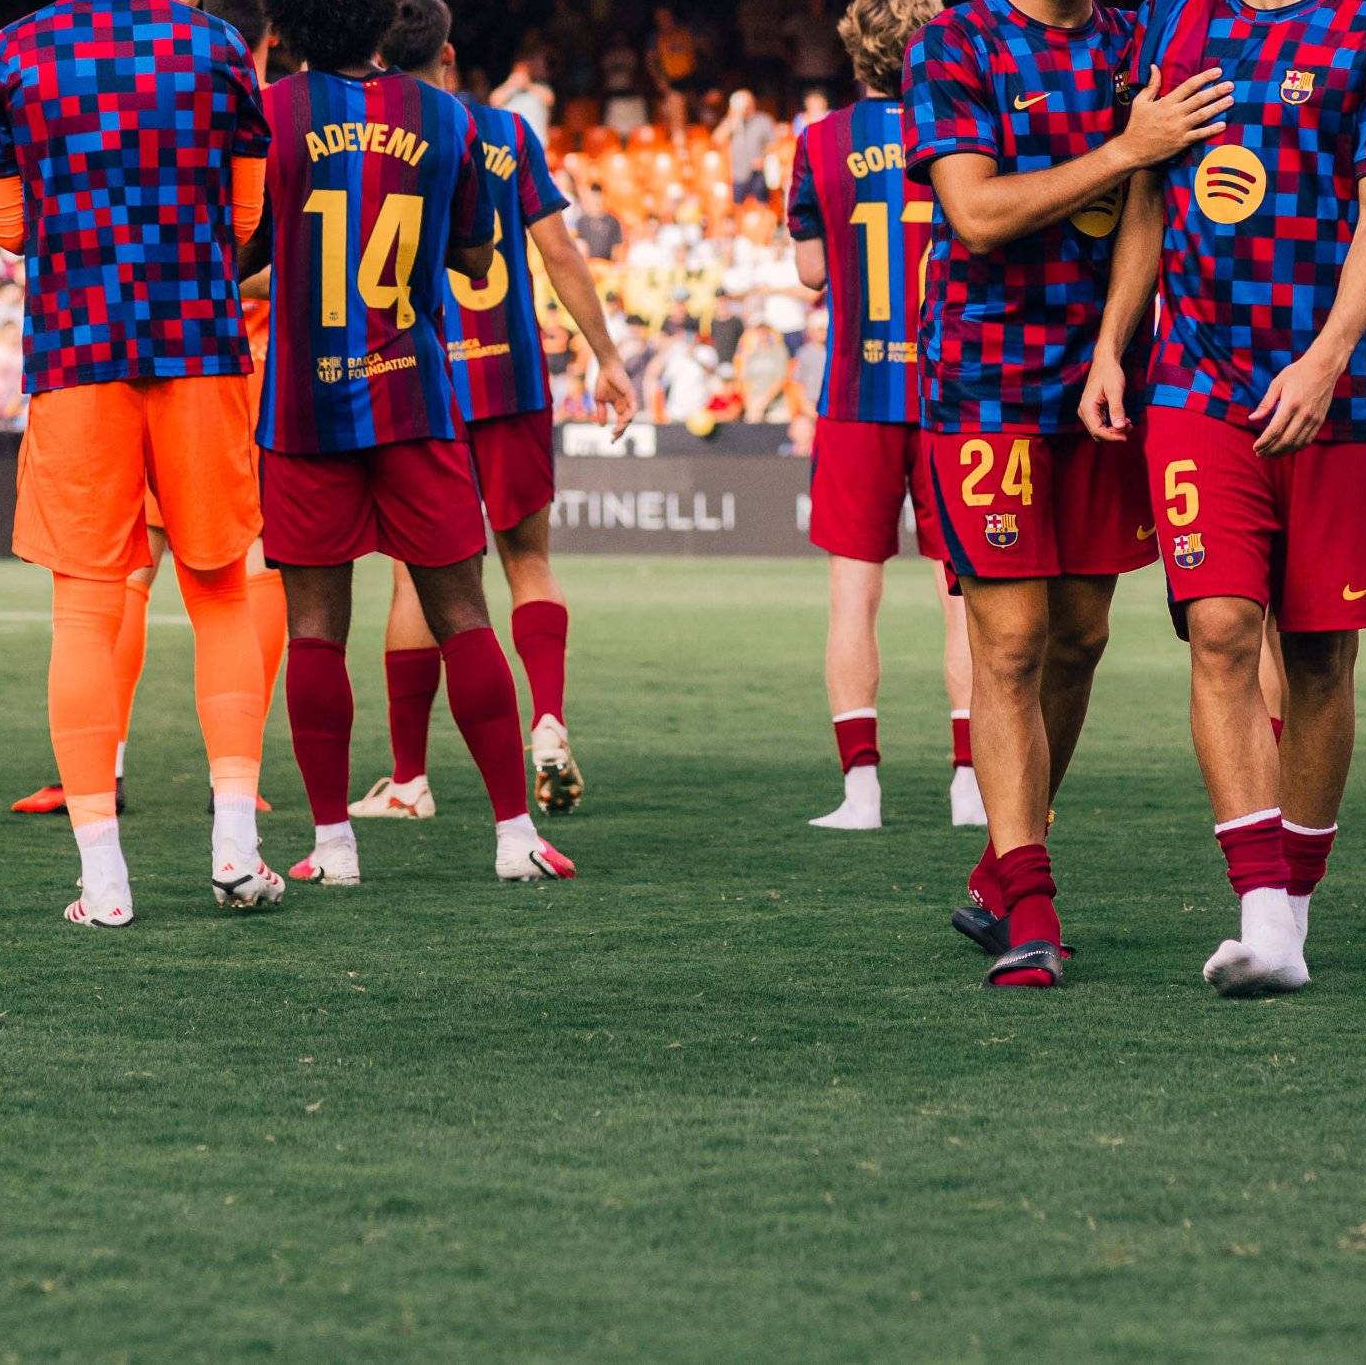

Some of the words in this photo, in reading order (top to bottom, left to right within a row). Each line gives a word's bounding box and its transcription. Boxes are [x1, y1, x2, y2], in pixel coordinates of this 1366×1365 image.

[305, 122, 430, 167] ADEYEMI
[302, 189, 424, 330] 14
[347, 352, 383, 369] BARÇA
[348, 356, 417, 380] FOUNDATION
[960, 439, 1033, 506] 24
[1164, 459, 1199, 526] 5
